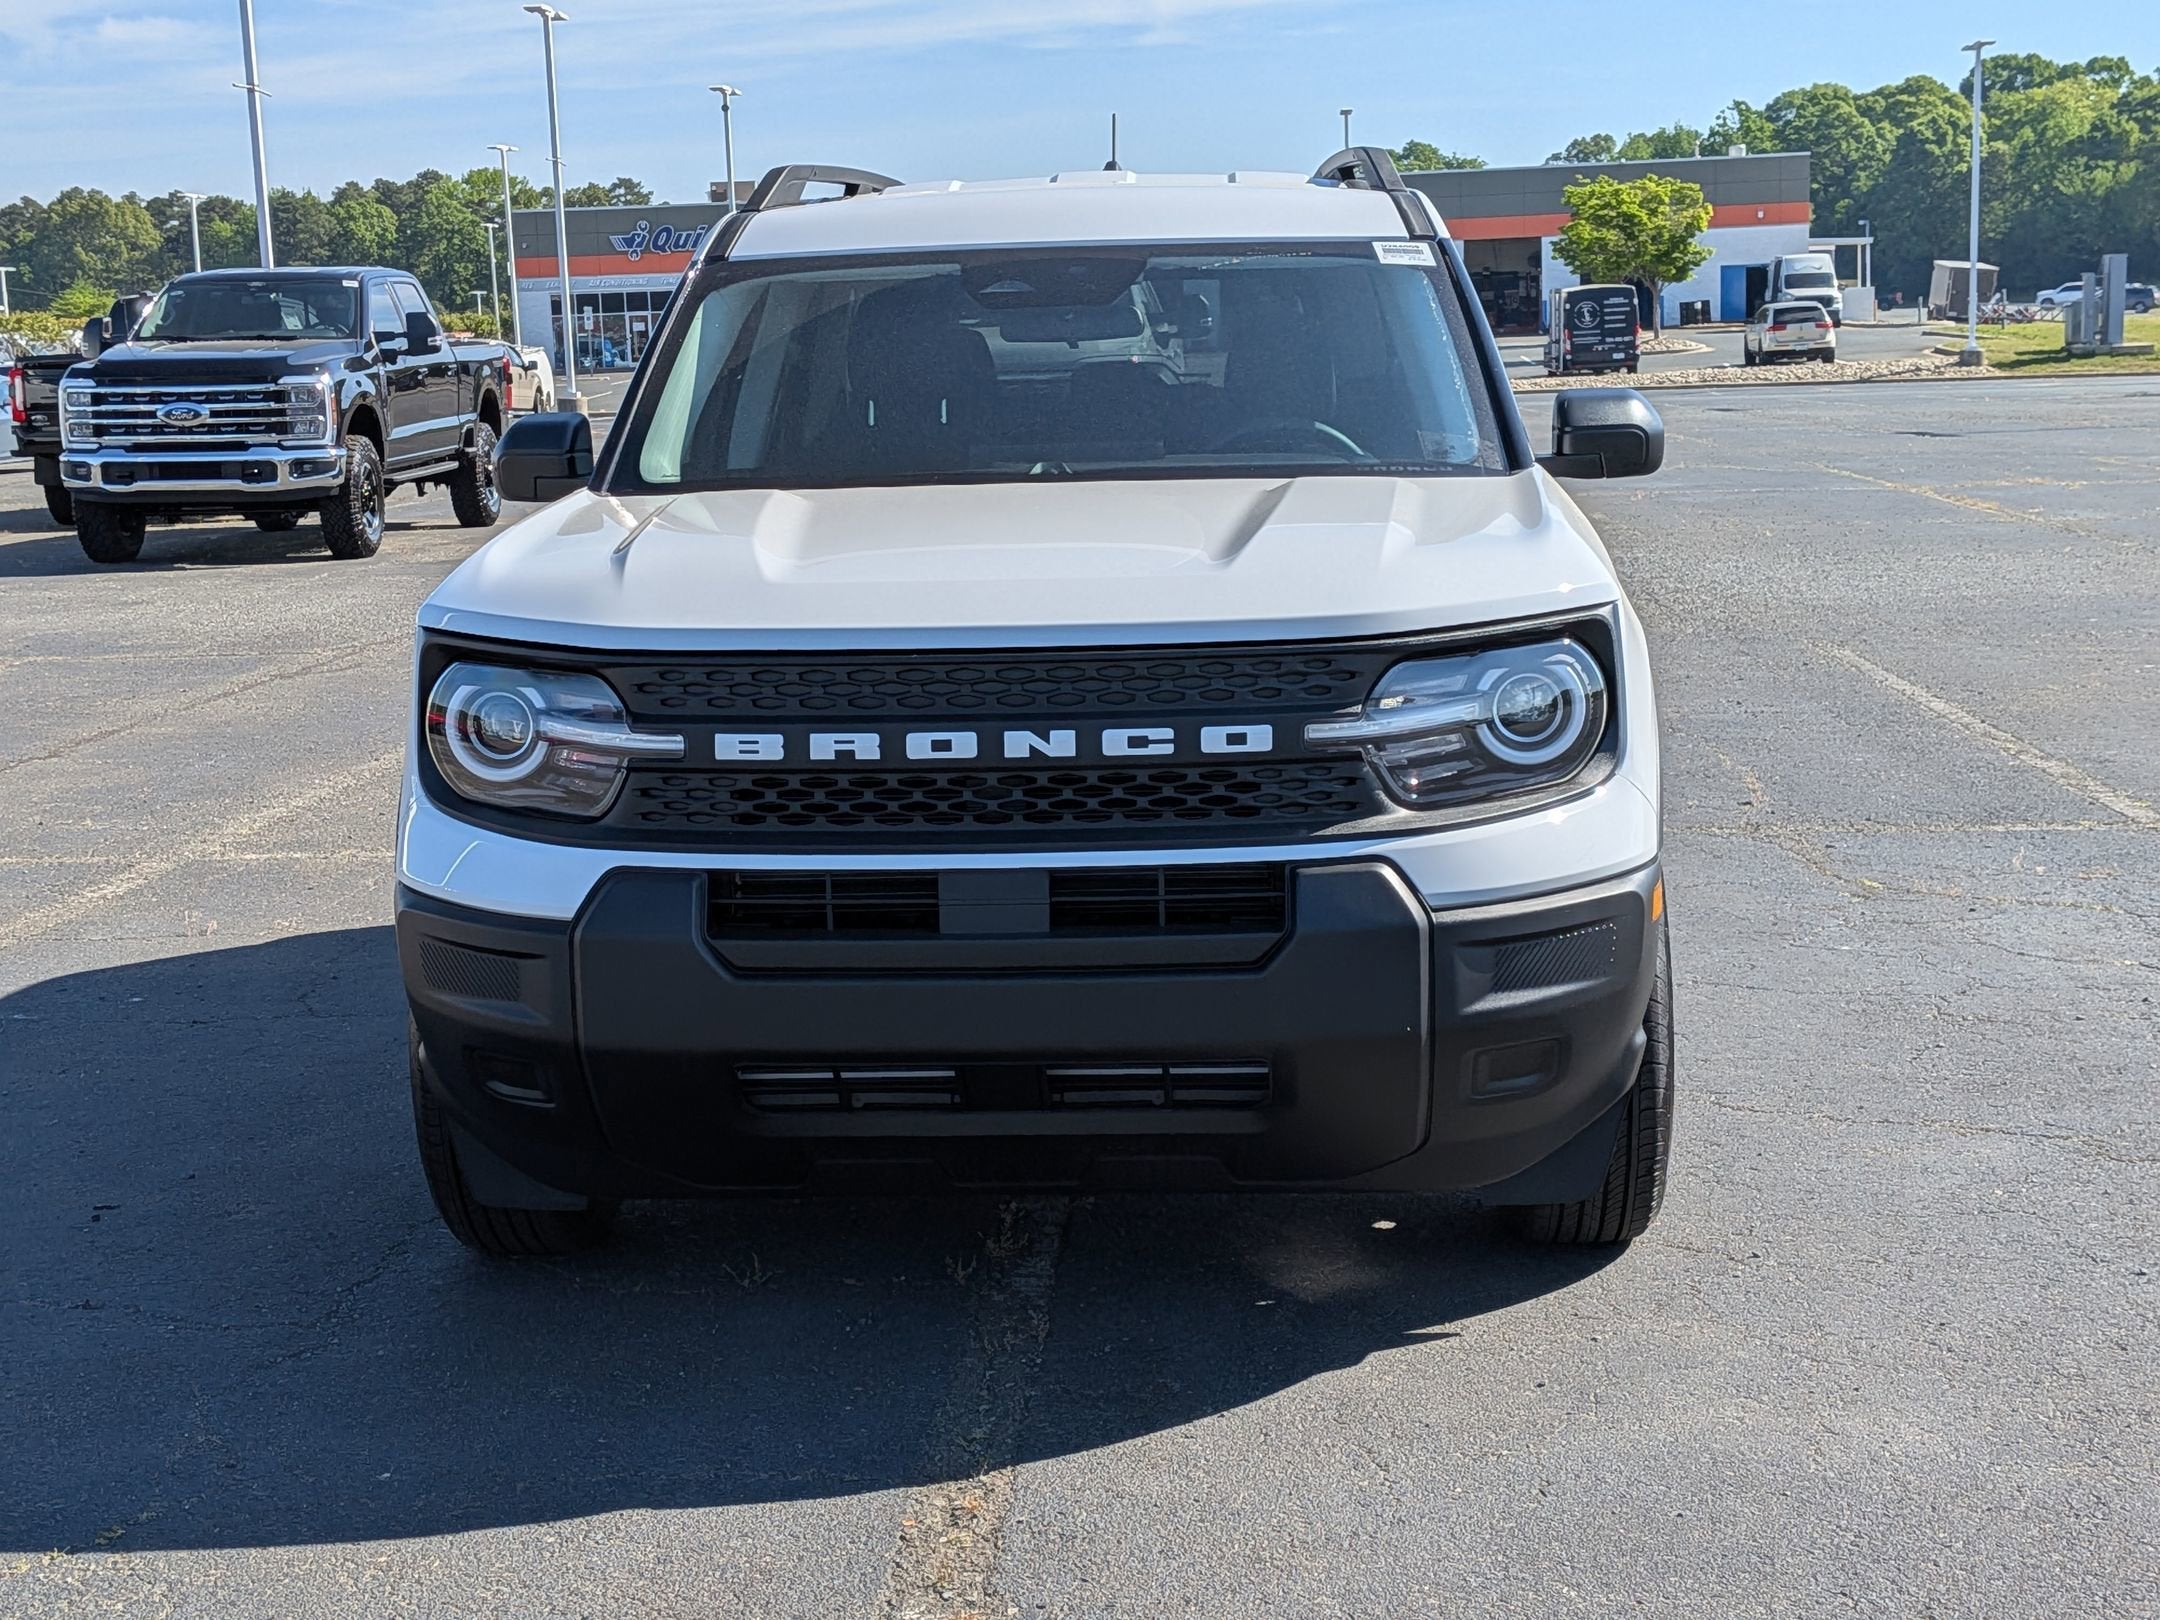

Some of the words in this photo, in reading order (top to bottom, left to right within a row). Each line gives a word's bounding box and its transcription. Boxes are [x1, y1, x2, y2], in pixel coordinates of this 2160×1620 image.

[650, 224, 708, 255] Qui
[169, 408, 195, 420] Ford
[714, 724, 1273, 760] BRONCO
